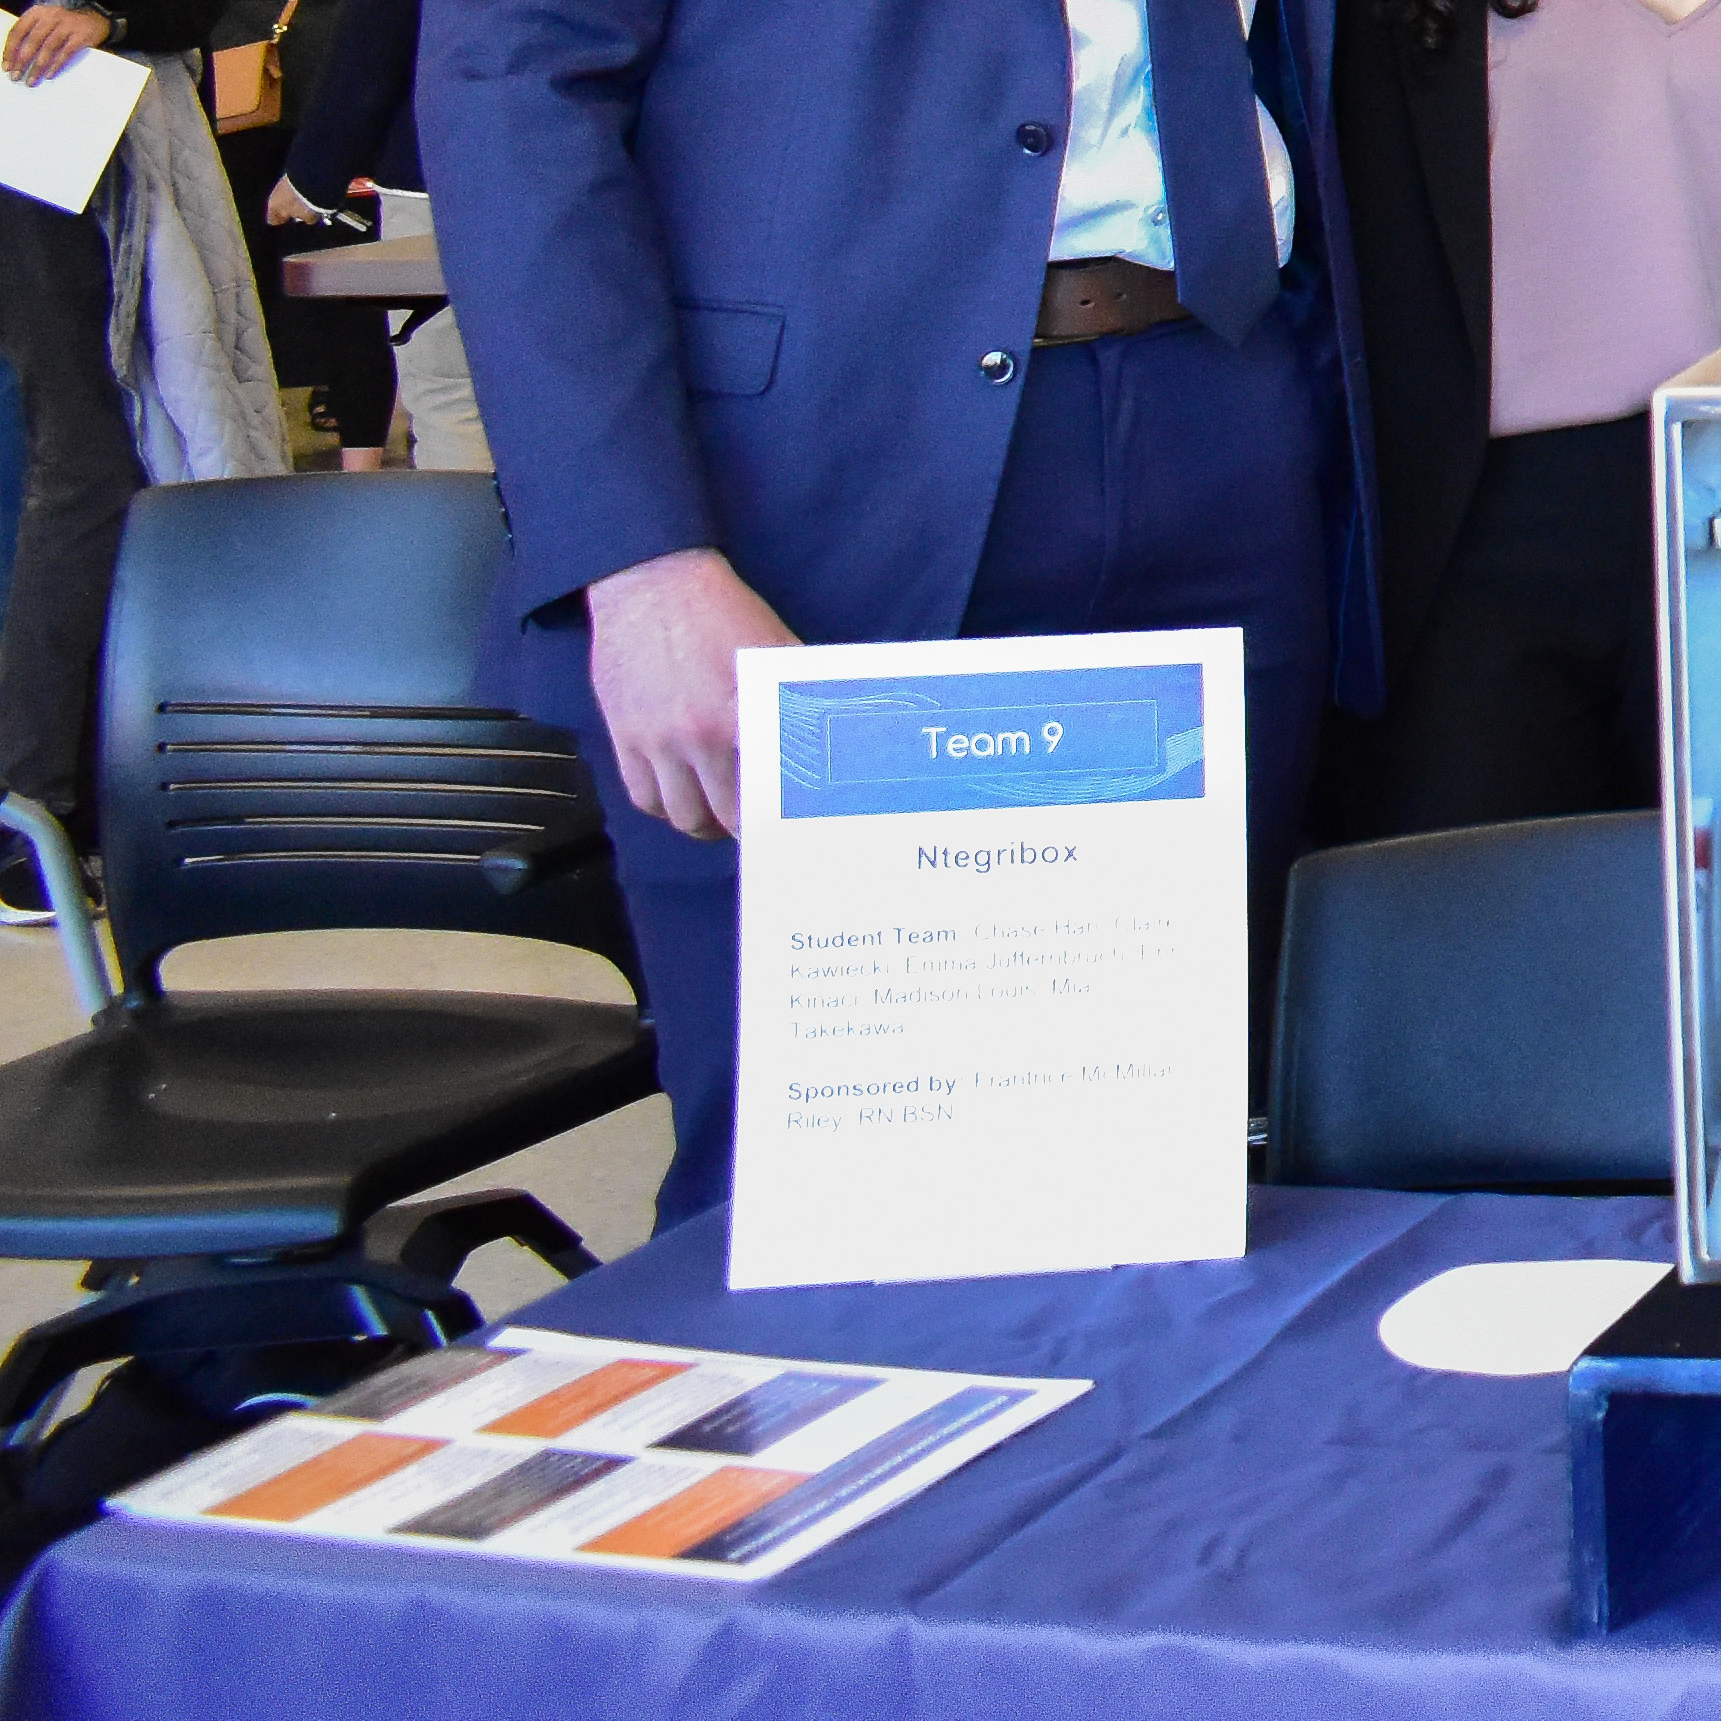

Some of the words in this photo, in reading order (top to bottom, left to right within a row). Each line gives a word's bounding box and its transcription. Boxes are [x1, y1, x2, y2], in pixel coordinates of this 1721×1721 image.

[922, 725, 1030, 759] Team
[1043, 721, 1064, 753] 9
[918, 841, 1078, 874] Ntegribox
[790, 932, 883, 950] Student
[788, 1077, 920, 1102] Sponsored
[904, 1104, 954, 1124] BSN
